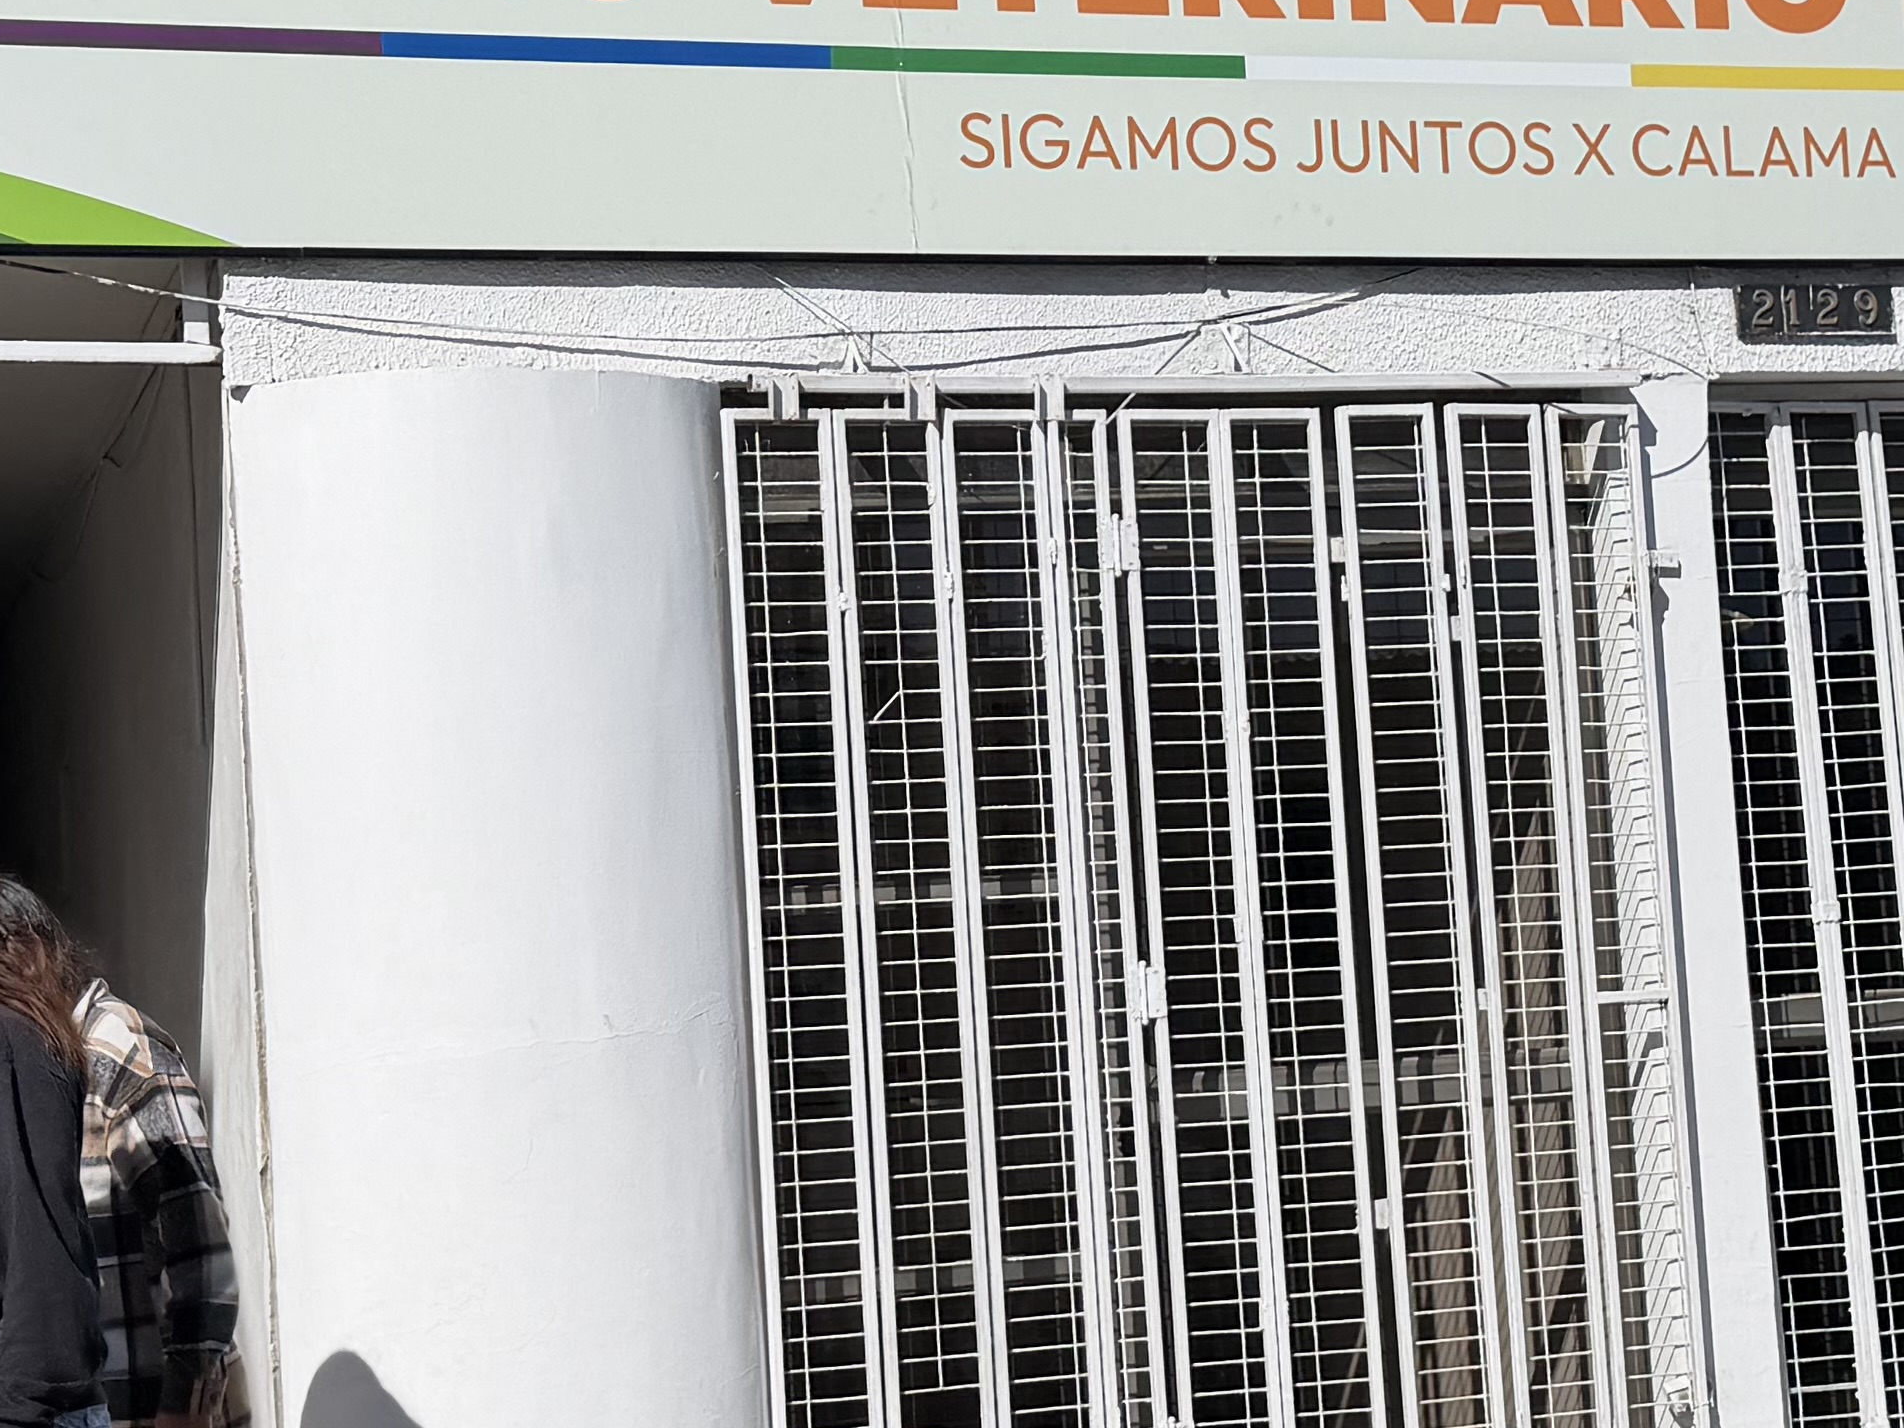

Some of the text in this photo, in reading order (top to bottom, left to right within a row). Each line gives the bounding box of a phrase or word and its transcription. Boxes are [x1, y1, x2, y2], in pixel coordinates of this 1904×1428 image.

[961, 112, 1896, 178] SIGAMOS JUNTOS X CALAMA
[1752, 288, 1879, 326] 2129
